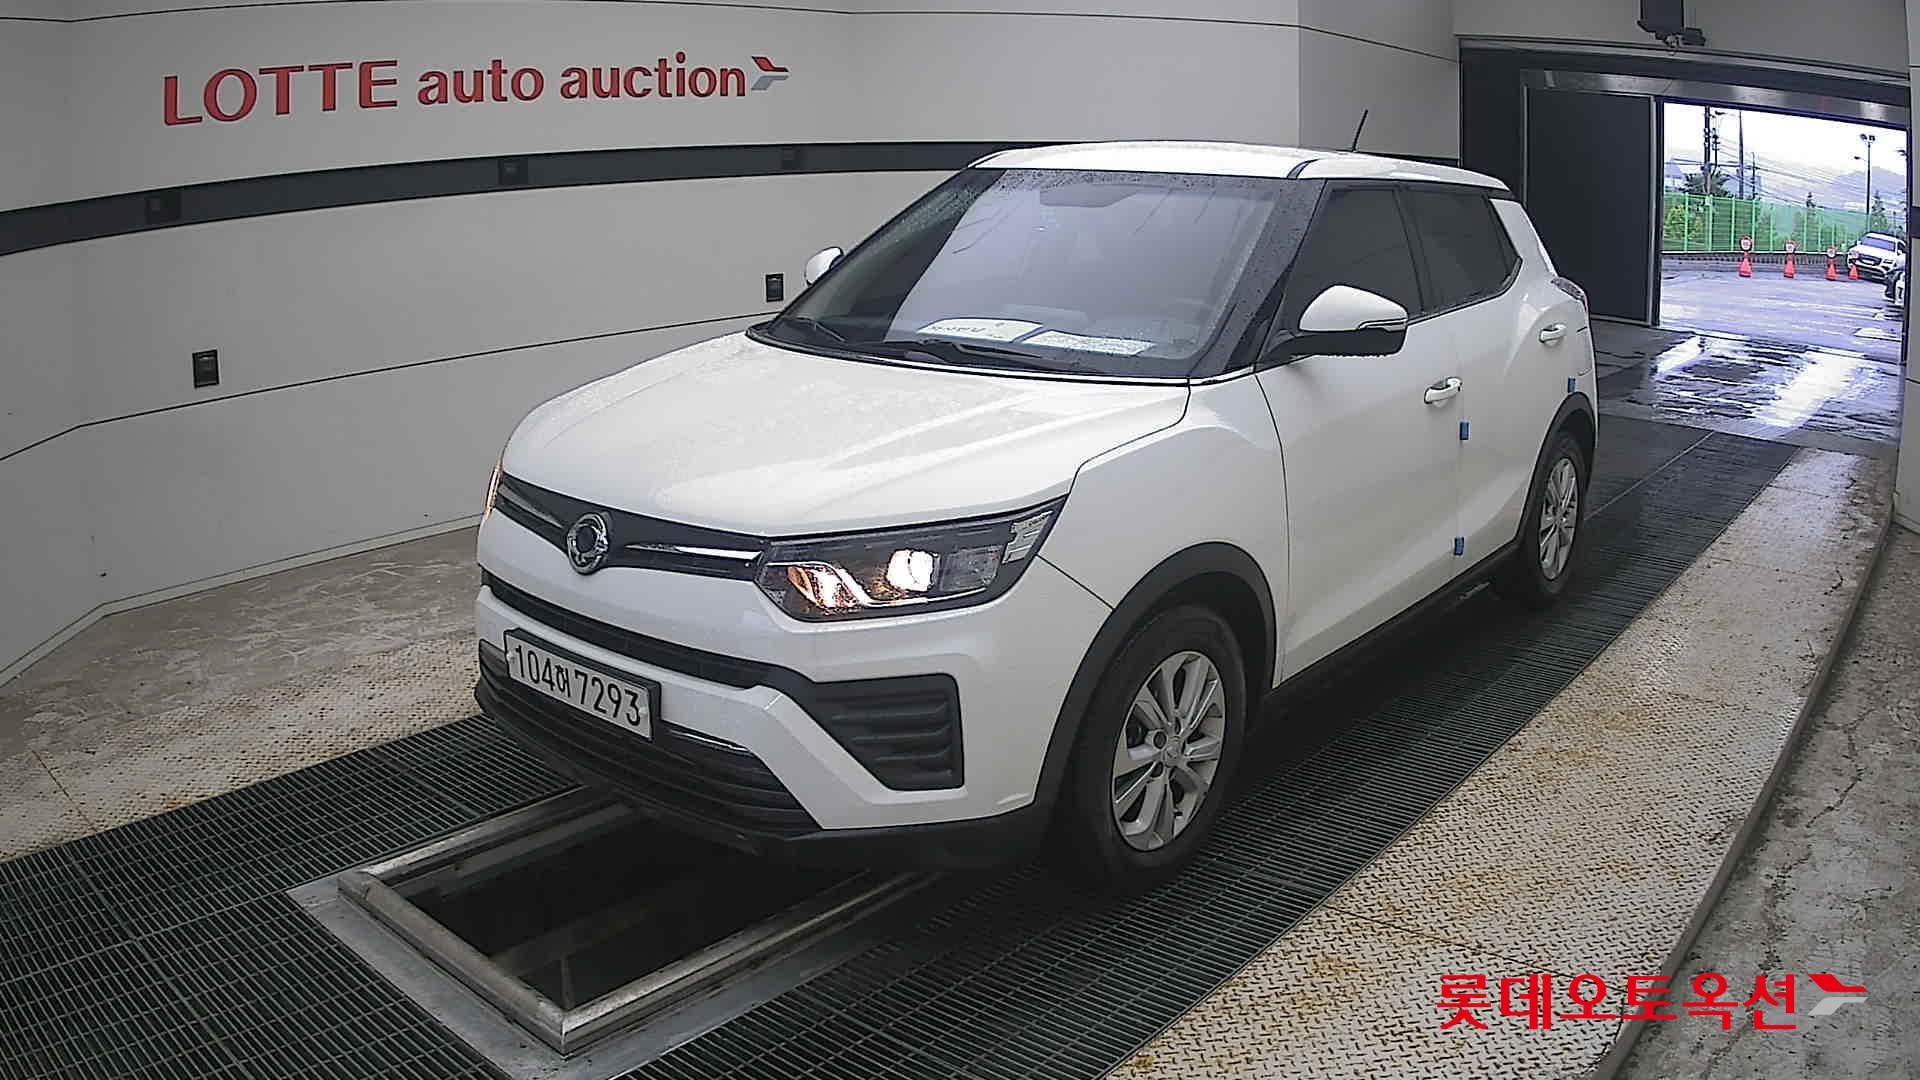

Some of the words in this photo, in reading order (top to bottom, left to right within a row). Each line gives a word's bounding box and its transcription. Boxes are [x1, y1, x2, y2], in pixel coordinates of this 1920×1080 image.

[163, 59, 399, 126] LOTTE
[417, 58, 545, 106] auto
[560, 51, 747, 99] auction
